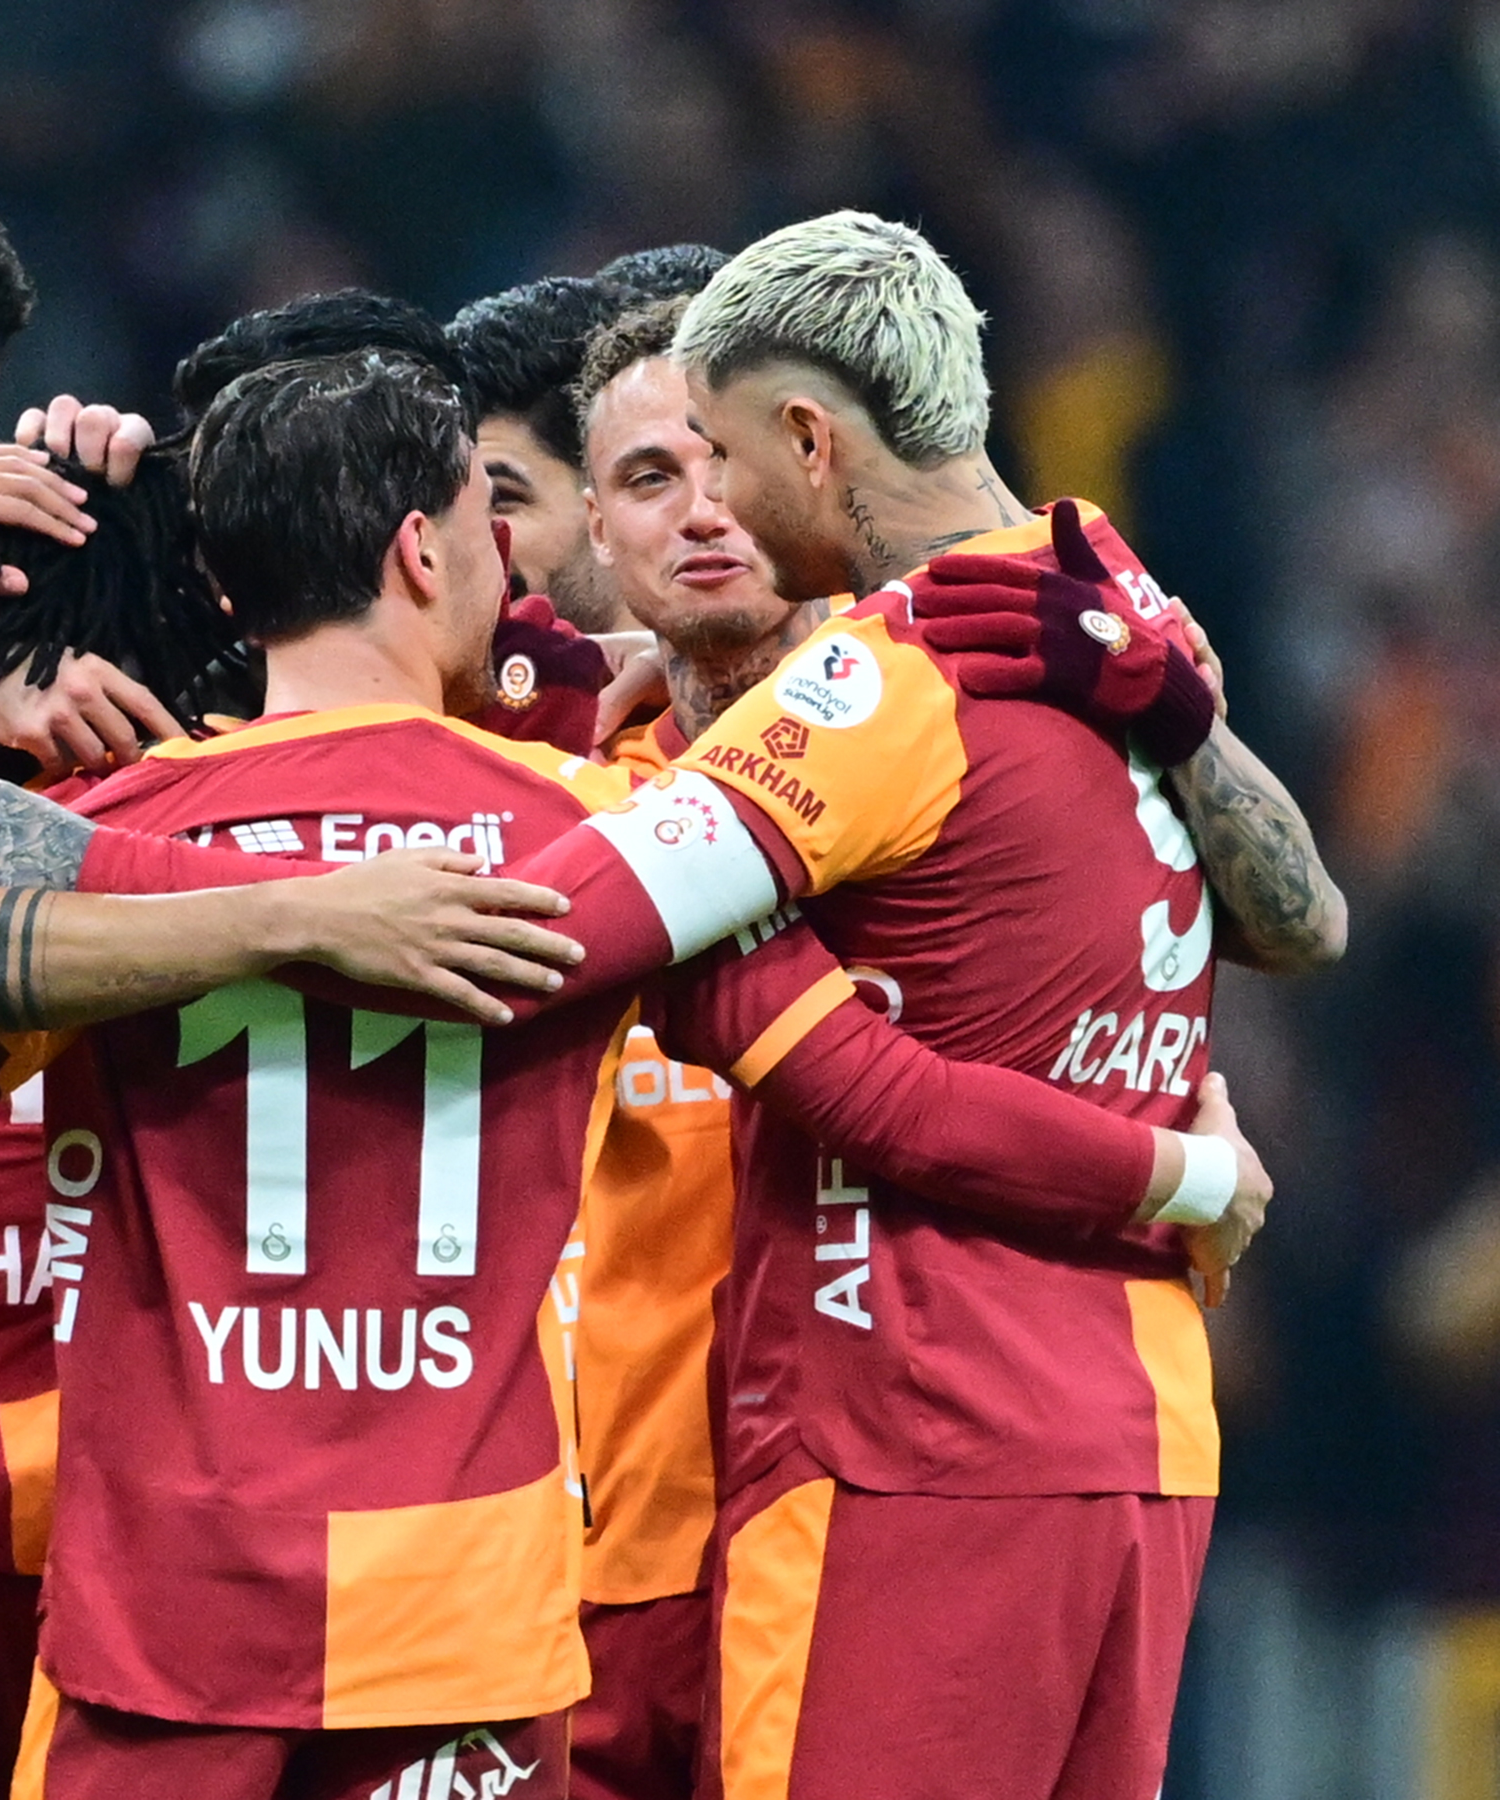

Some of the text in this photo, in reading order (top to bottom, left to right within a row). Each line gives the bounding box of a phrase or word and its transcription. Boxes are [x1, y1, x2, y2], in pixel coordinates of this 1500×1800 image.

[697, 744, 827, 828] ARKHAM
[176, 977, 483, 1276] 11
[187, 1301, 474, 1390] YUNUS
